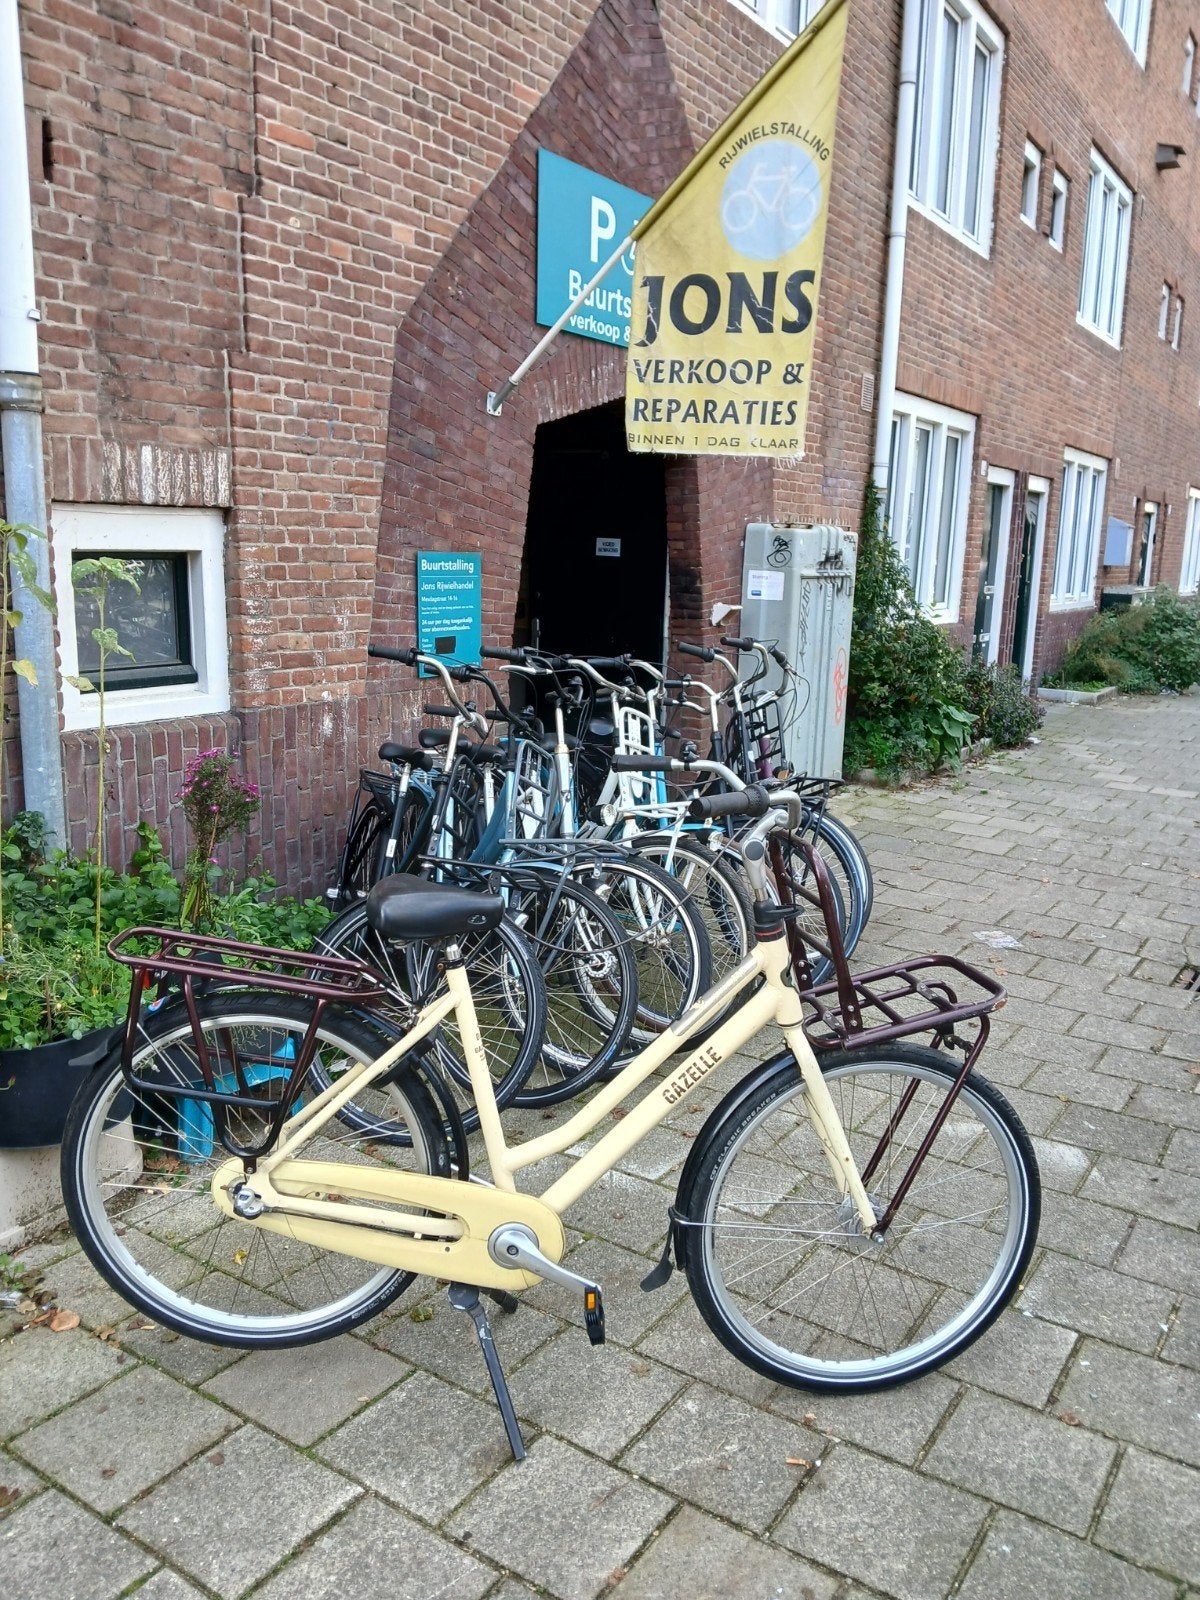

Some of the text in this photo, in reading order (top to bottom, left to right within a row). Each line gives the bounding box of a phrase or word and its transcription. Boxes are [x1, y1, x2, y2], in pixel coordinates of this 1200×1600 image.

[718, 121, 831, 169] RIJWIELSTALLING
[590, 195, 616, 263] P
[634, 269, 816, 347] JONS
[569, 314, 620, 343] verkoop
[633, 358, 805, 385] VERKOOP &
[632, 397, 798, 426] REPARATIES
[628, 433, 685, 445] BINNEN
[694, 436, 698, 445] 1
[707, 436, 741, 447] DAG
[421, 558, 474, 574] Buurtstalling
[421, 580, 474, 592] Jons Rijwielhandel
[662, 1046, 722, 1104] GAZELLE
[717, 1128, 742, 1163] CLASSIC
[741, 1093, 776, 1127] BREAKER
